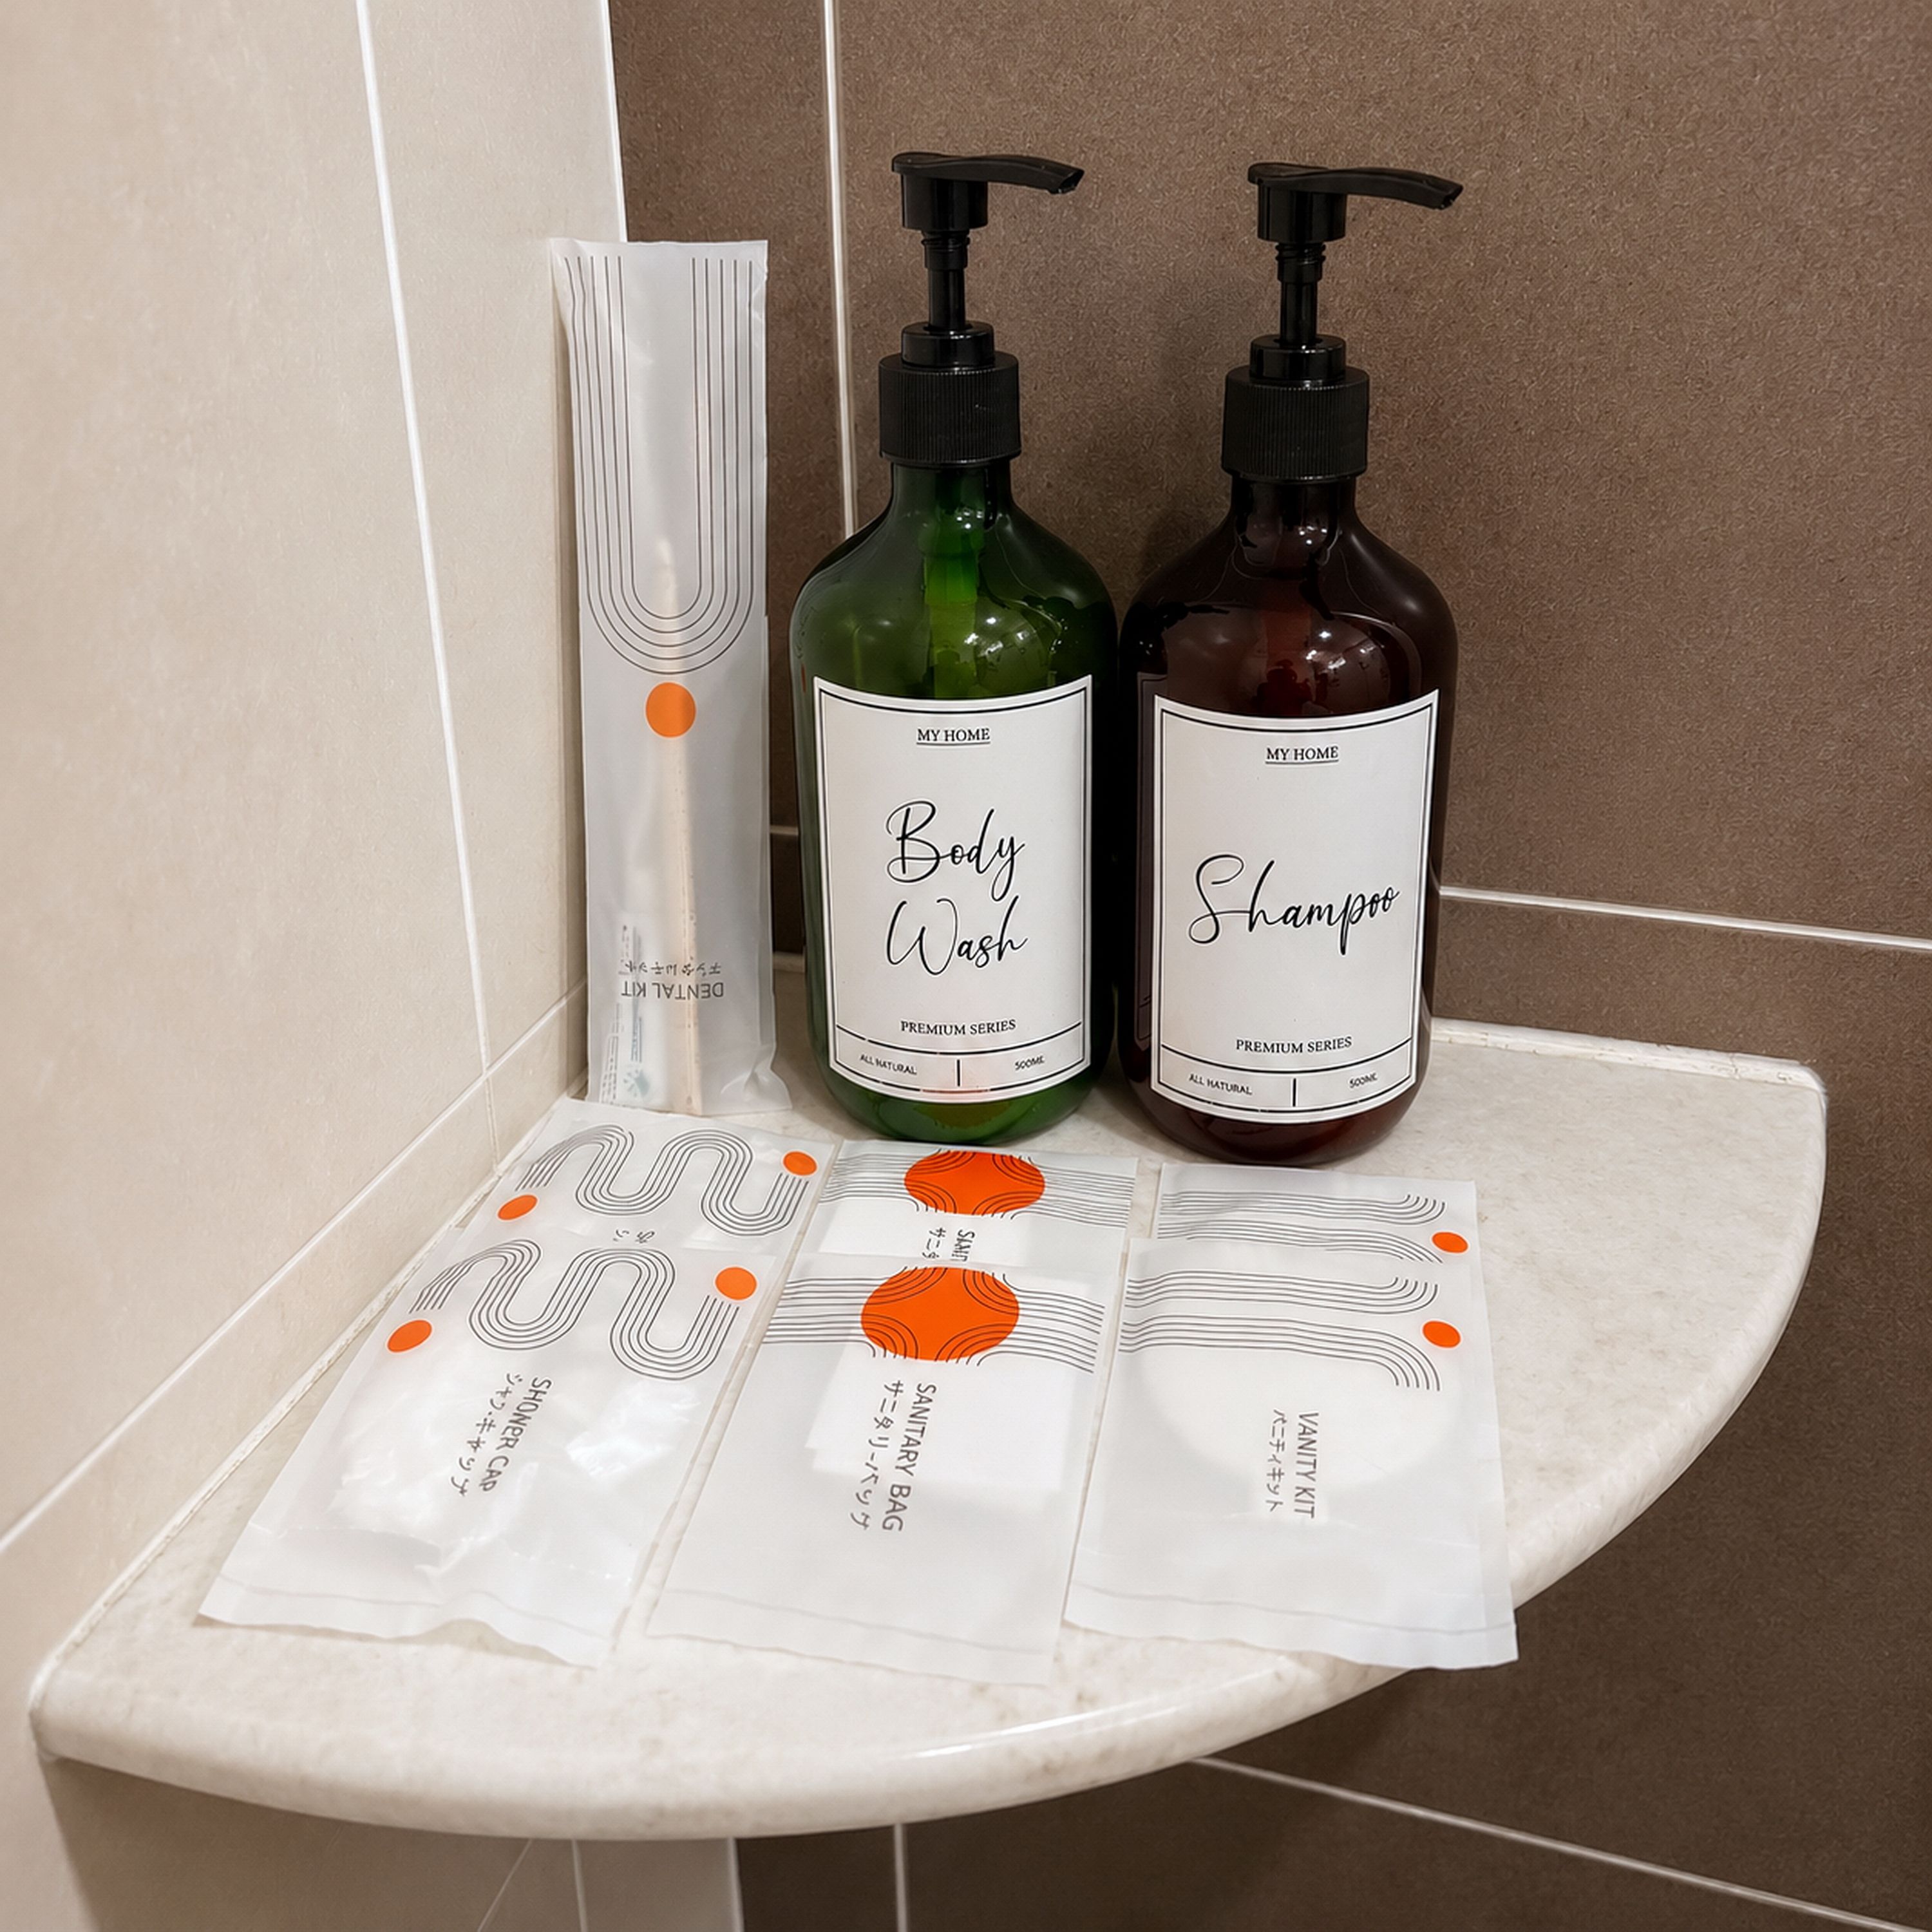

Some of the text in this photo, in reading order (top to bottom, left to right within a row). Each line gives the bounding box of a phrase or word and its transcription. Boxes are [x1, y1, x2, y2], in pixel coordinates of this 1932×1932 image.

[917, 728, 990, 742] MY HOME
[1267, 746, 1338, 761] MY HOME
[886, 800, 1025, 901] Body
[1188, 854, 1400, 956] Shampoo
[886, 896, 1028, 976] Wash
[621, 981, 724, 999] DENTAL KIT
[900, 1019, 1016, 1036] PREMIUM SERIES
[1236, 1036, 1352, 1054] PREMIUM SERIES
[860, 1054, 917, 1075] ALL NATURAL
[1189, 1074, 1253, 1095] ALL NATURAL
[882, 1383, 937, 1531] SANITARY BAG
[1294, 1412, 1319, 1519] VANITY KIT
[478, 1455, 509, 1492] CAP
